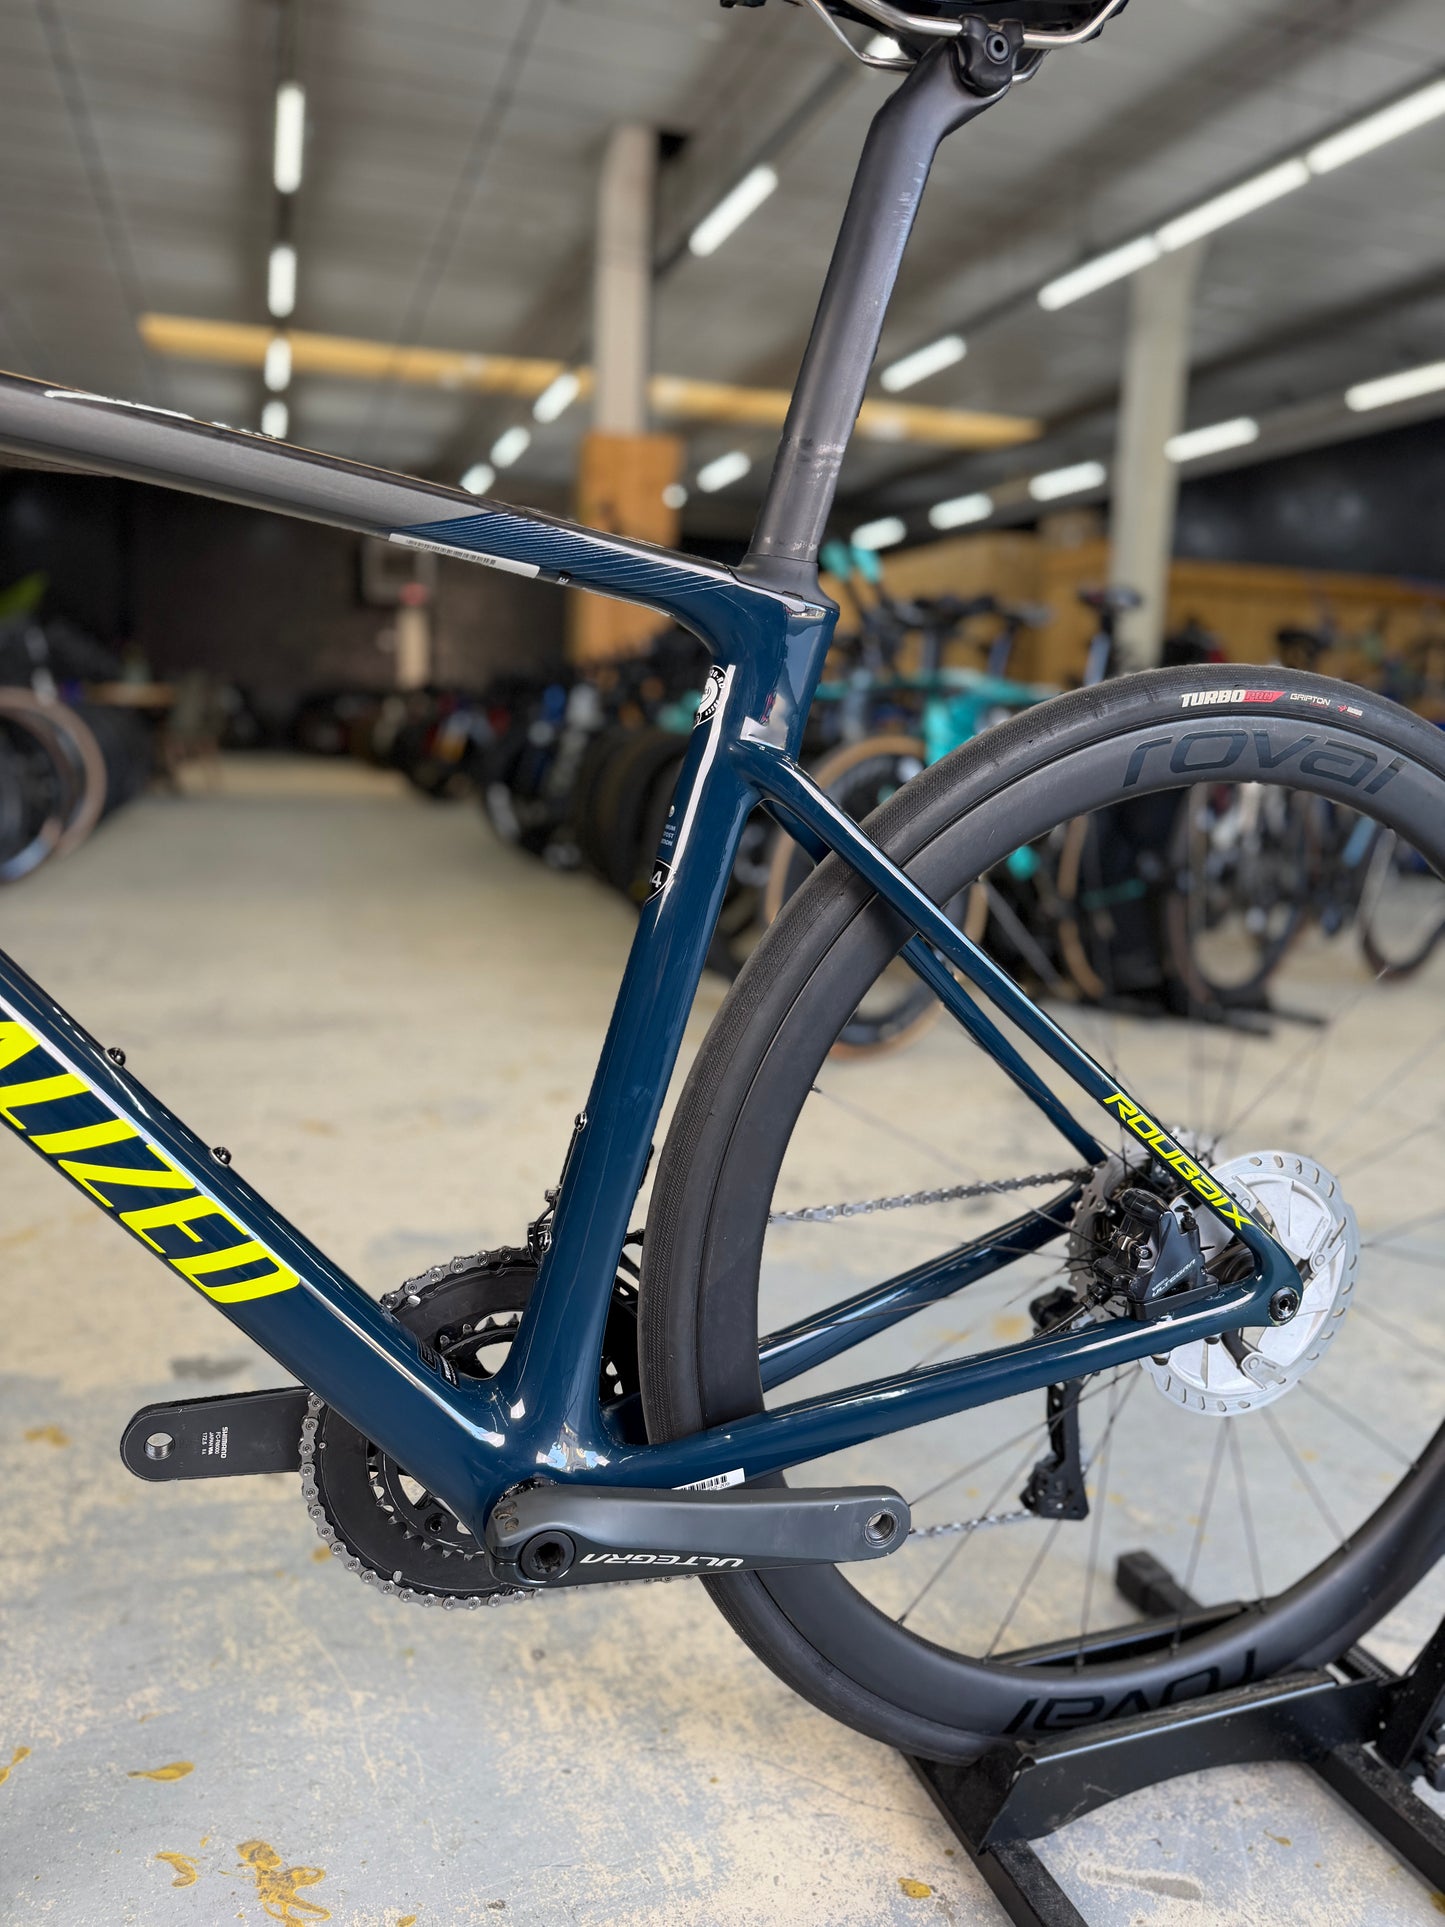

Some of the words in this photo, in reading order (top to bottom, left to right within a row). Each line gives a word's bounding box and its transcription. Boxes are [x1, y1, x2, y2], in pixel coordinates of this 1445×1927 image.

[1181, 689, 1246, 708] TURBO
[1290, 693, 1331, 706] GRIPTON
[220, 1426, 228, 1459] SHIMANO
[580, 1552, 744, 1568] ULTEGRA
